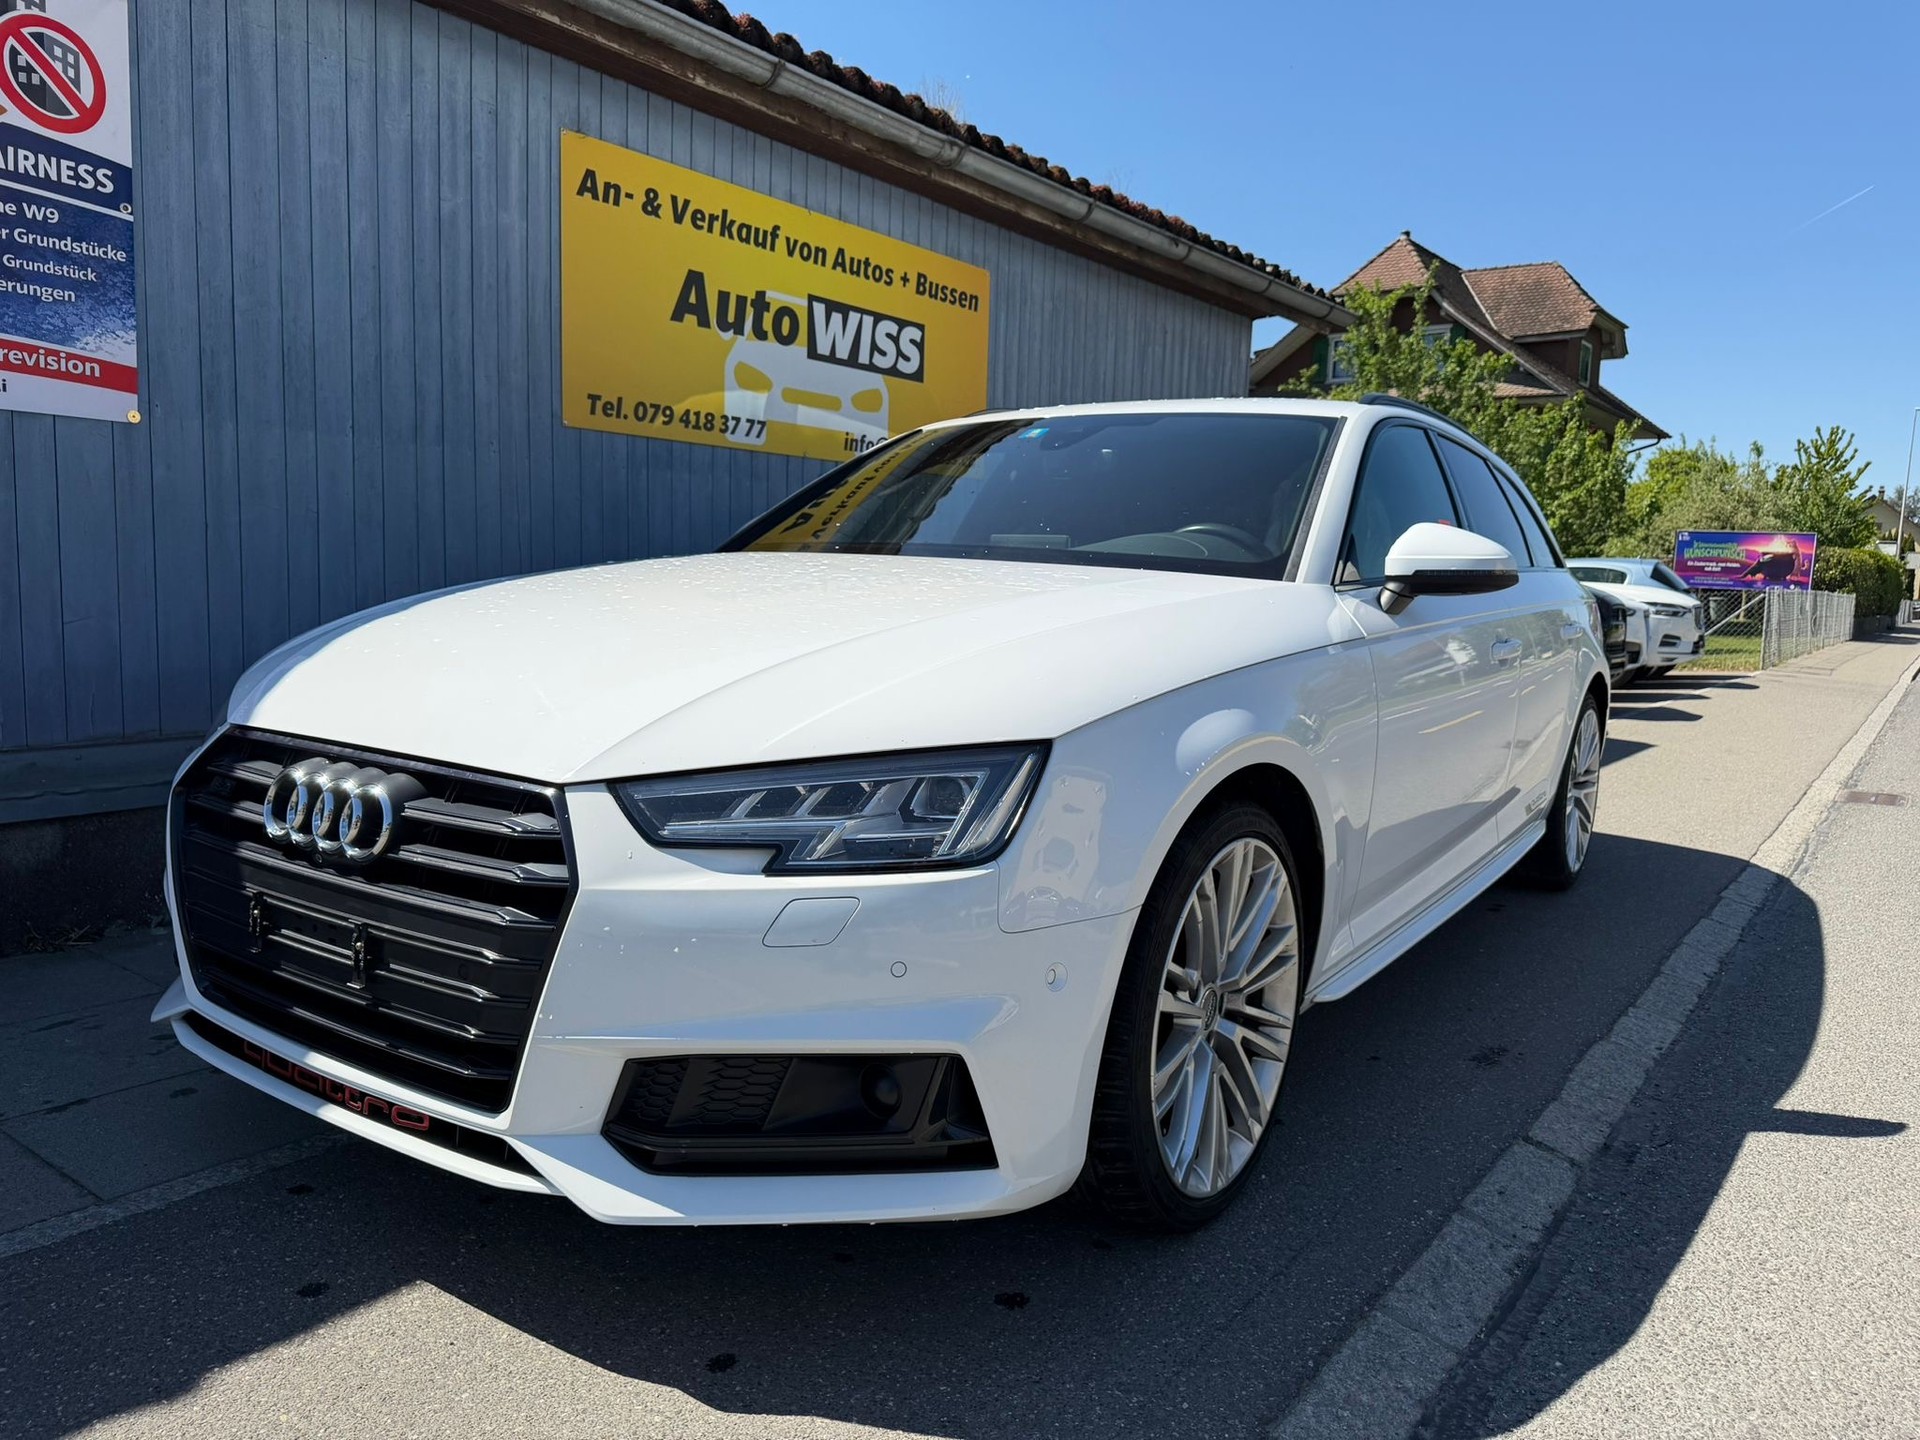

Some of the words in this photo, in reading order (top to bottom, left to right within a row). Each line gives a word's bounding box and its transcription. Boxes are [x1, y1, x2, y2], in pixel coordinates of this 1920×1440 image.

[0, 145, 114, 194] IRNESS
[22, 202, 59, 224] W9
[13, 228, 127, 262] Grundstücke
[576, 168, 634, 207] An-
[641, 187, 662, 219] &
[670, 194, 780, 252] Verkauf
[785, 236, 828, 267] von
[832, 247, 894, 287] Autos
[900, 272, 910, 288] +
[915, 272, 979, 312] Bussen
[2, 254, 97, 282] Grundstück
[670, 269, 800, 346] Auto
[811, 300, 924, 375] WISS
[587, 393, 629, 420] Tel.
[633, 401, 674, 426] 079
[679, 408, 715, 432] 418
[719, 414, 741, 435] 37
[745, 418, 767, 439] 77
